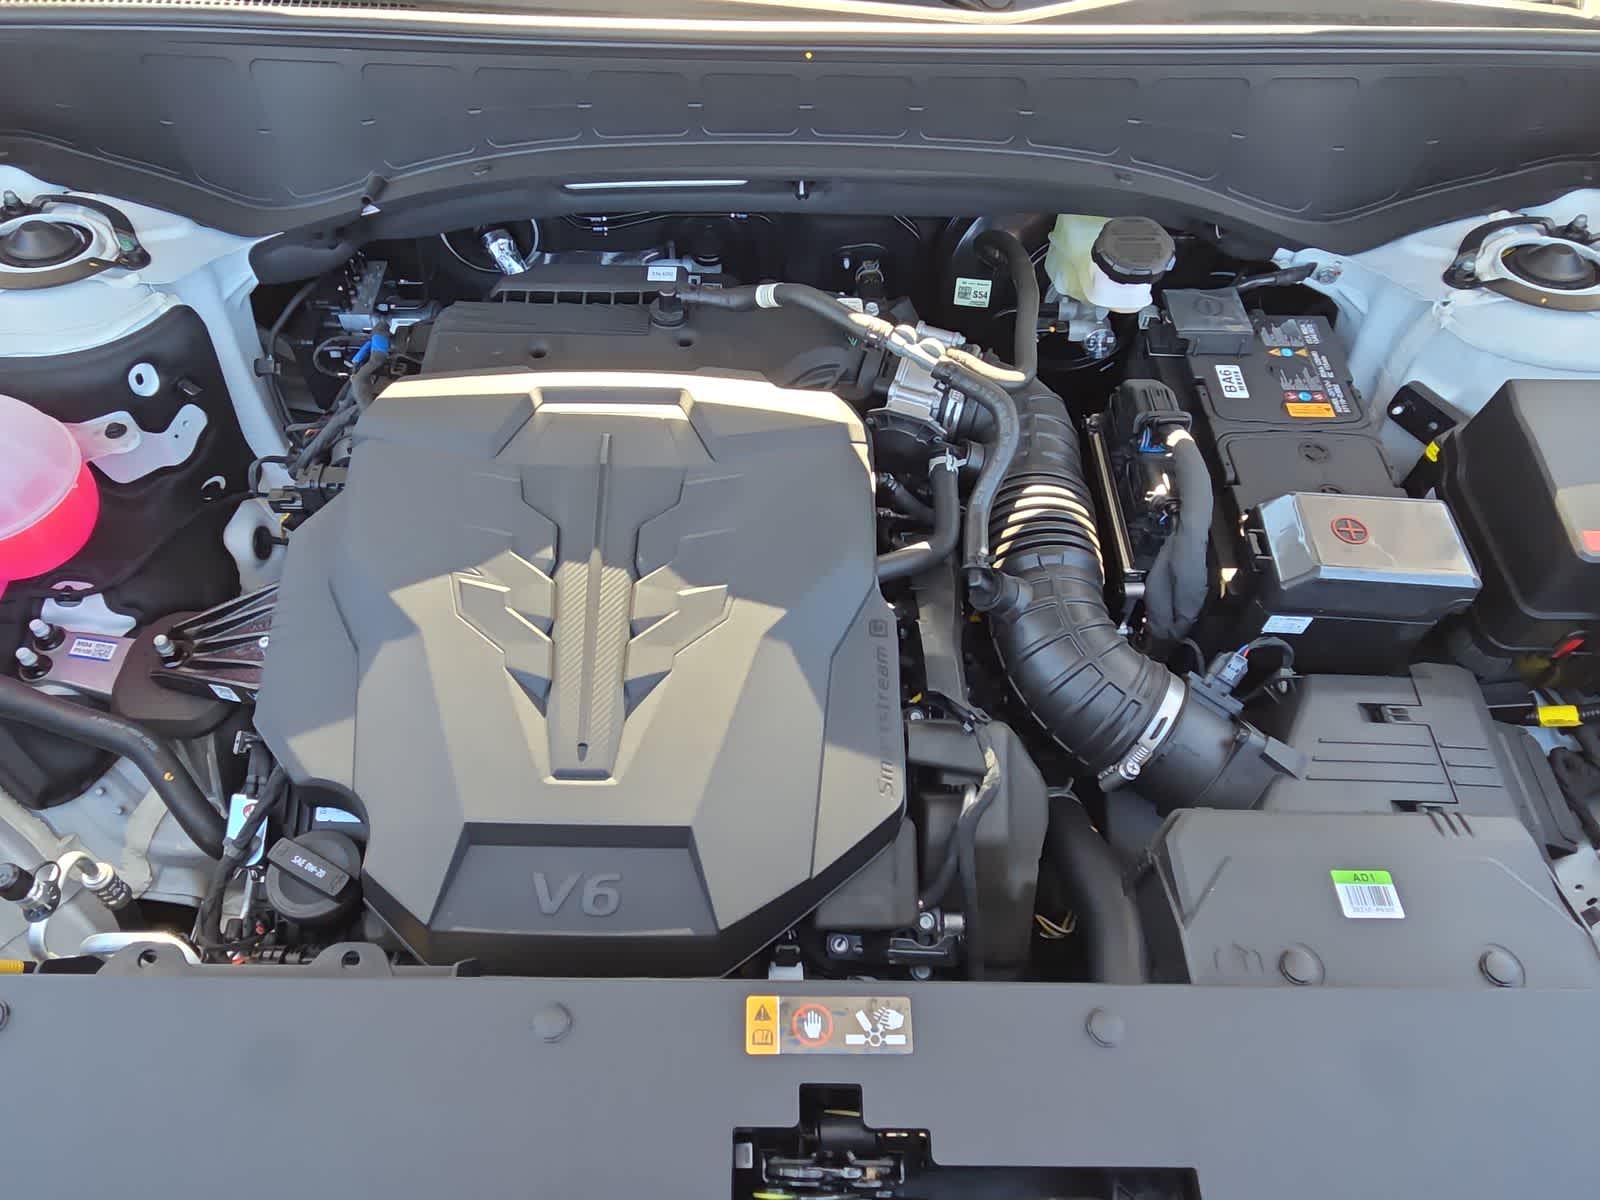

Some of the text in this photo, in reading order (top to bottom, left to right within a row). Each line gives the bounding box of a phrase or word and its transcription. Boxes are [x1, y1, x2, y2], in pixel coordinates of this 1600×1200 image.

[1219, 369, 1238, 393] BA6
[875, 646, 894, 798] Smtstream
[290, 855, 307, 867] SAE
[1353, 873, 1376, 883] AD1
[532, 871, 621, 917] V6
